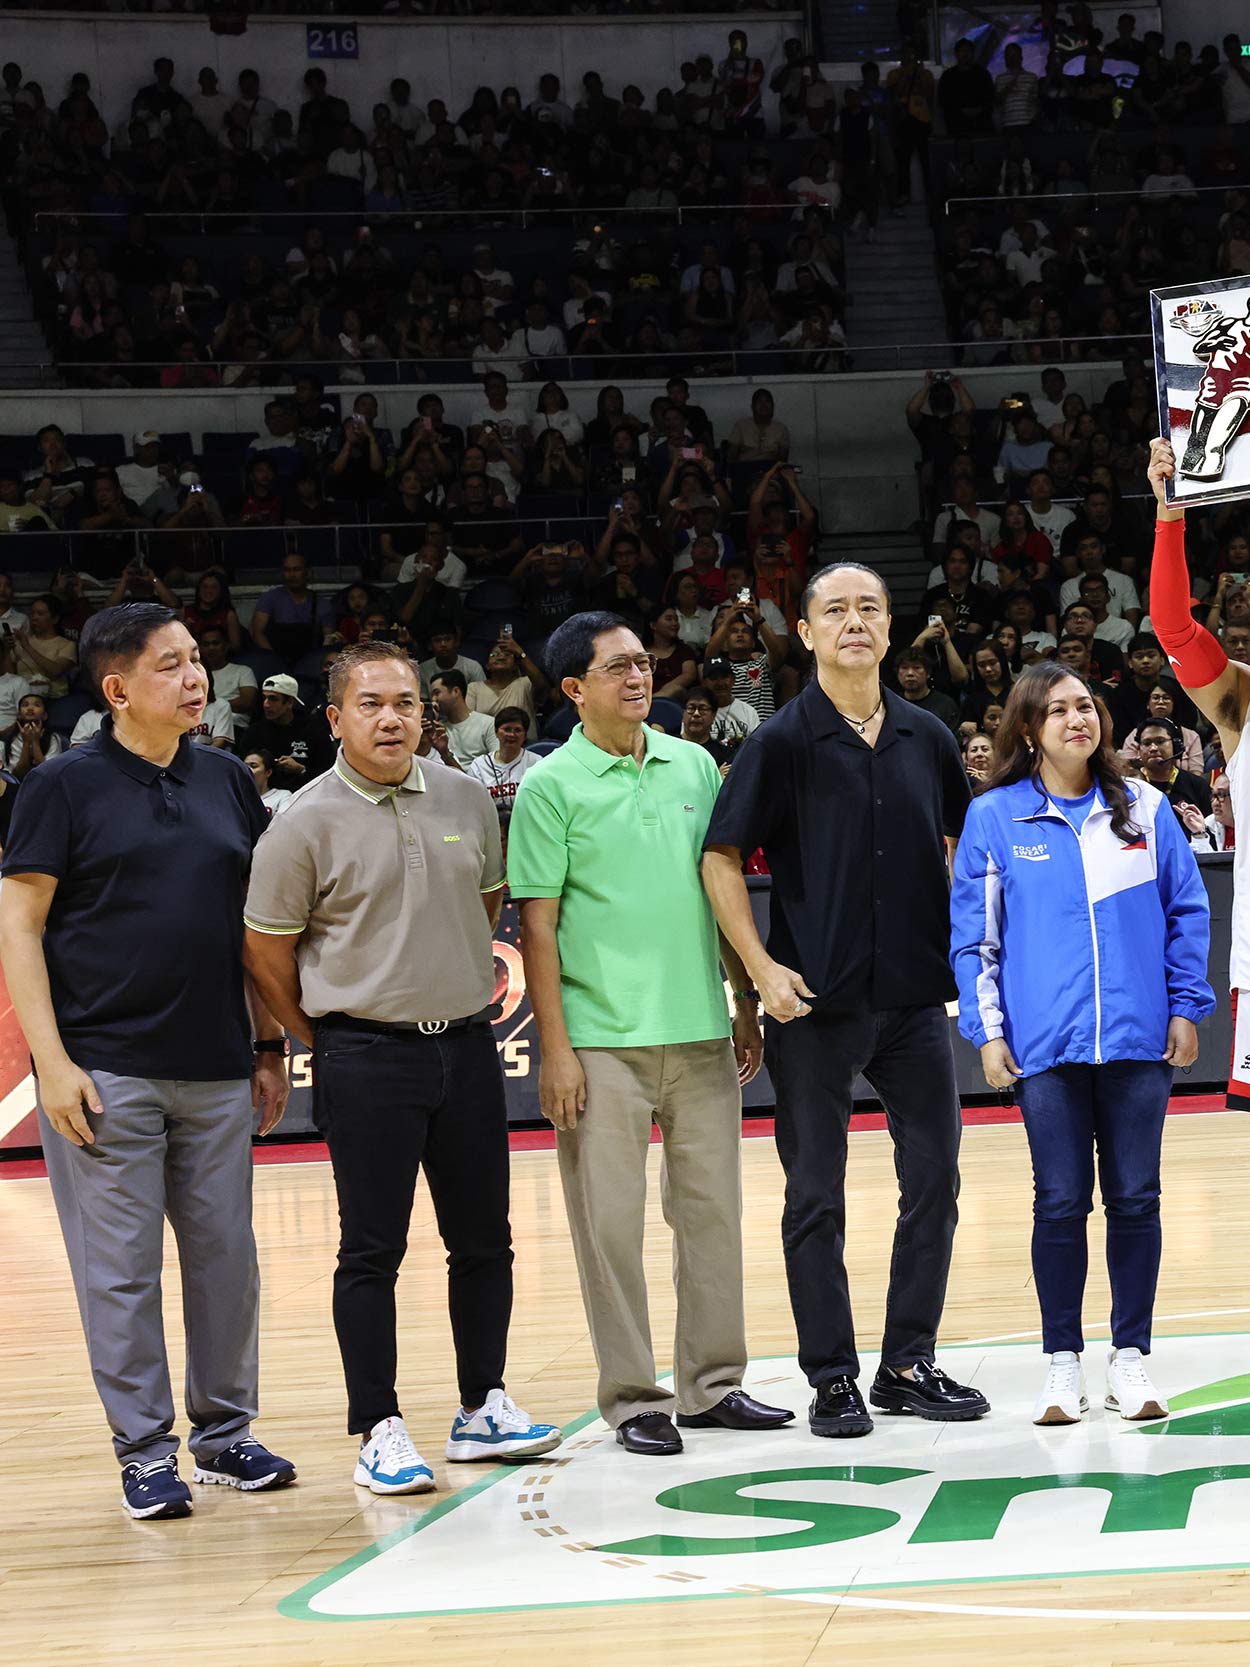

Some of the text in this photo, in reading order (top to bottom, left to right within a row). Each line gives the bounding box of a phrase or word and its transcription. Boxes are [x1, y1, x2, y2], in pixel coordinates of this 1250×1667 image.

[309, 29, 357, 52] 216
[1012, 844, 1048, 852] POCARI
[1013, 849, 1045, 857] SWEAT
